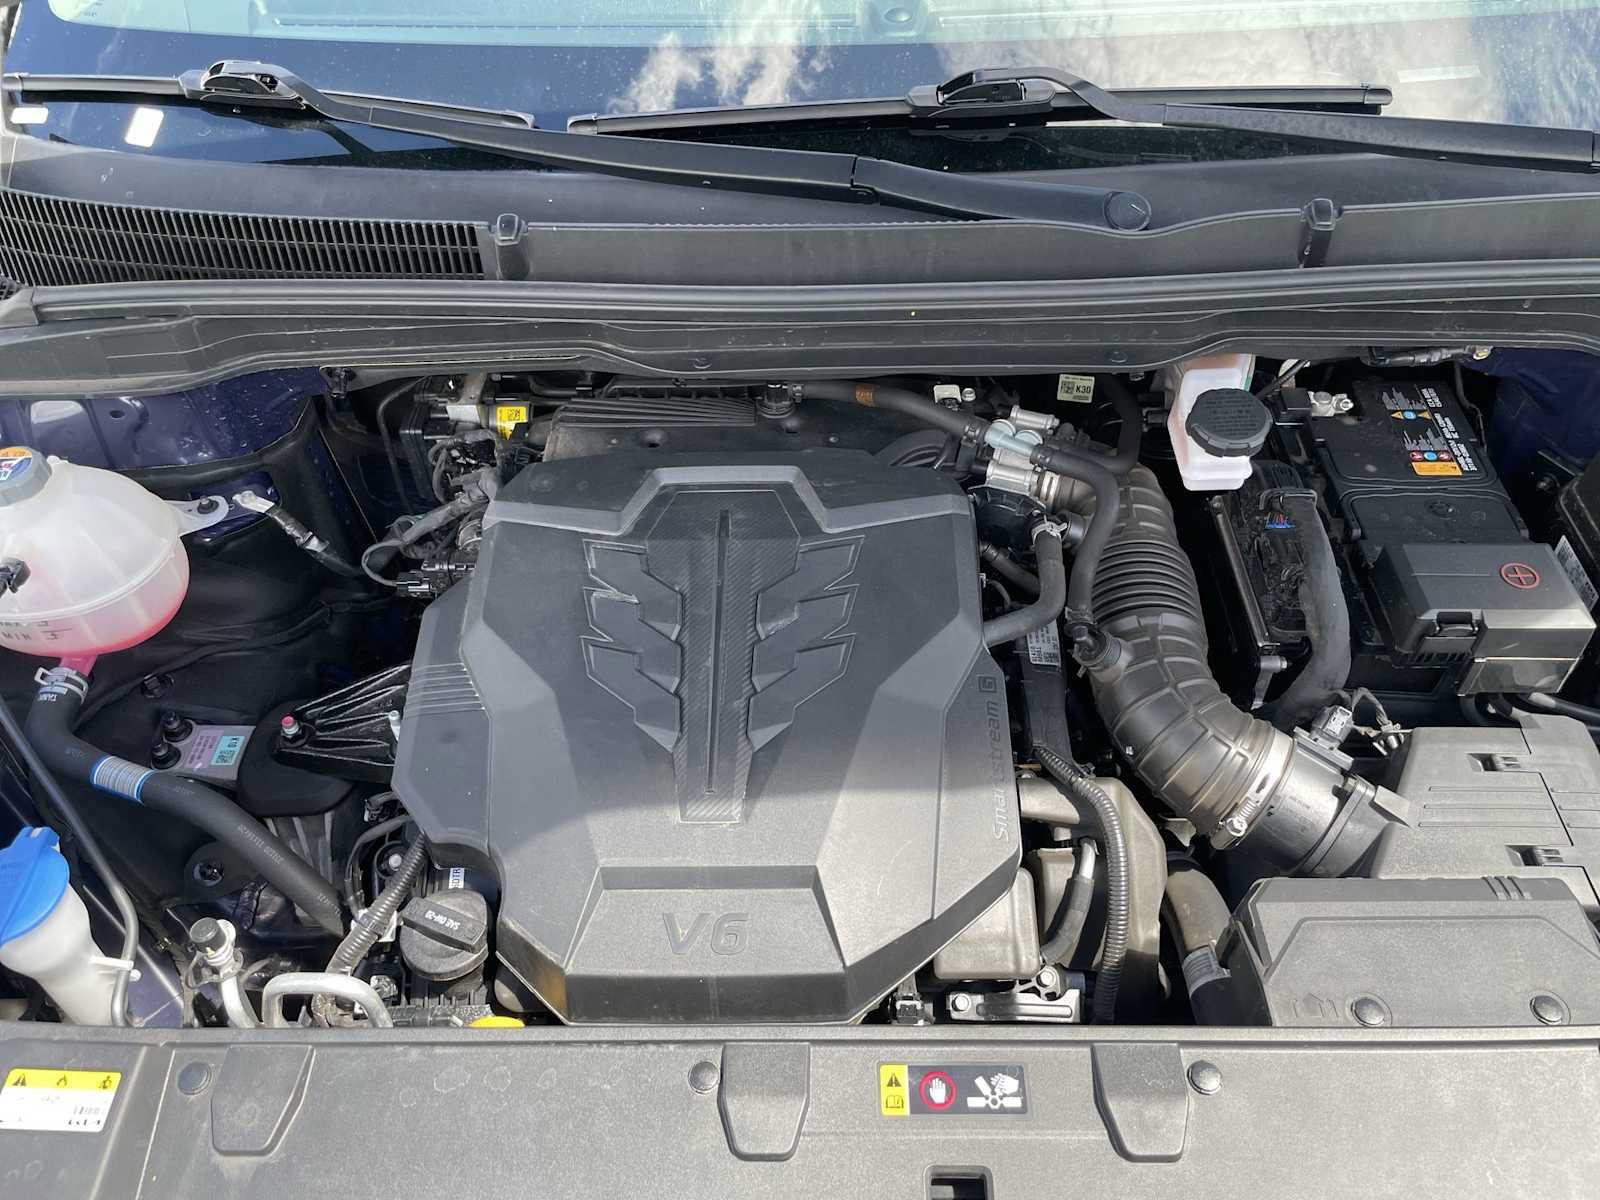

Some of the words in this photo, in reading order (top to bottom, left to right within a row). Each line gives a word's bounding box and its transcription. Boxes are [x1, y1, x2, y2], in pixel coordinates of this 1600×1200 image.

[1075, 384, 1092, 394] K30
[445, 918, 461, 930] SAE
[662, 911, 750, 956] V6
